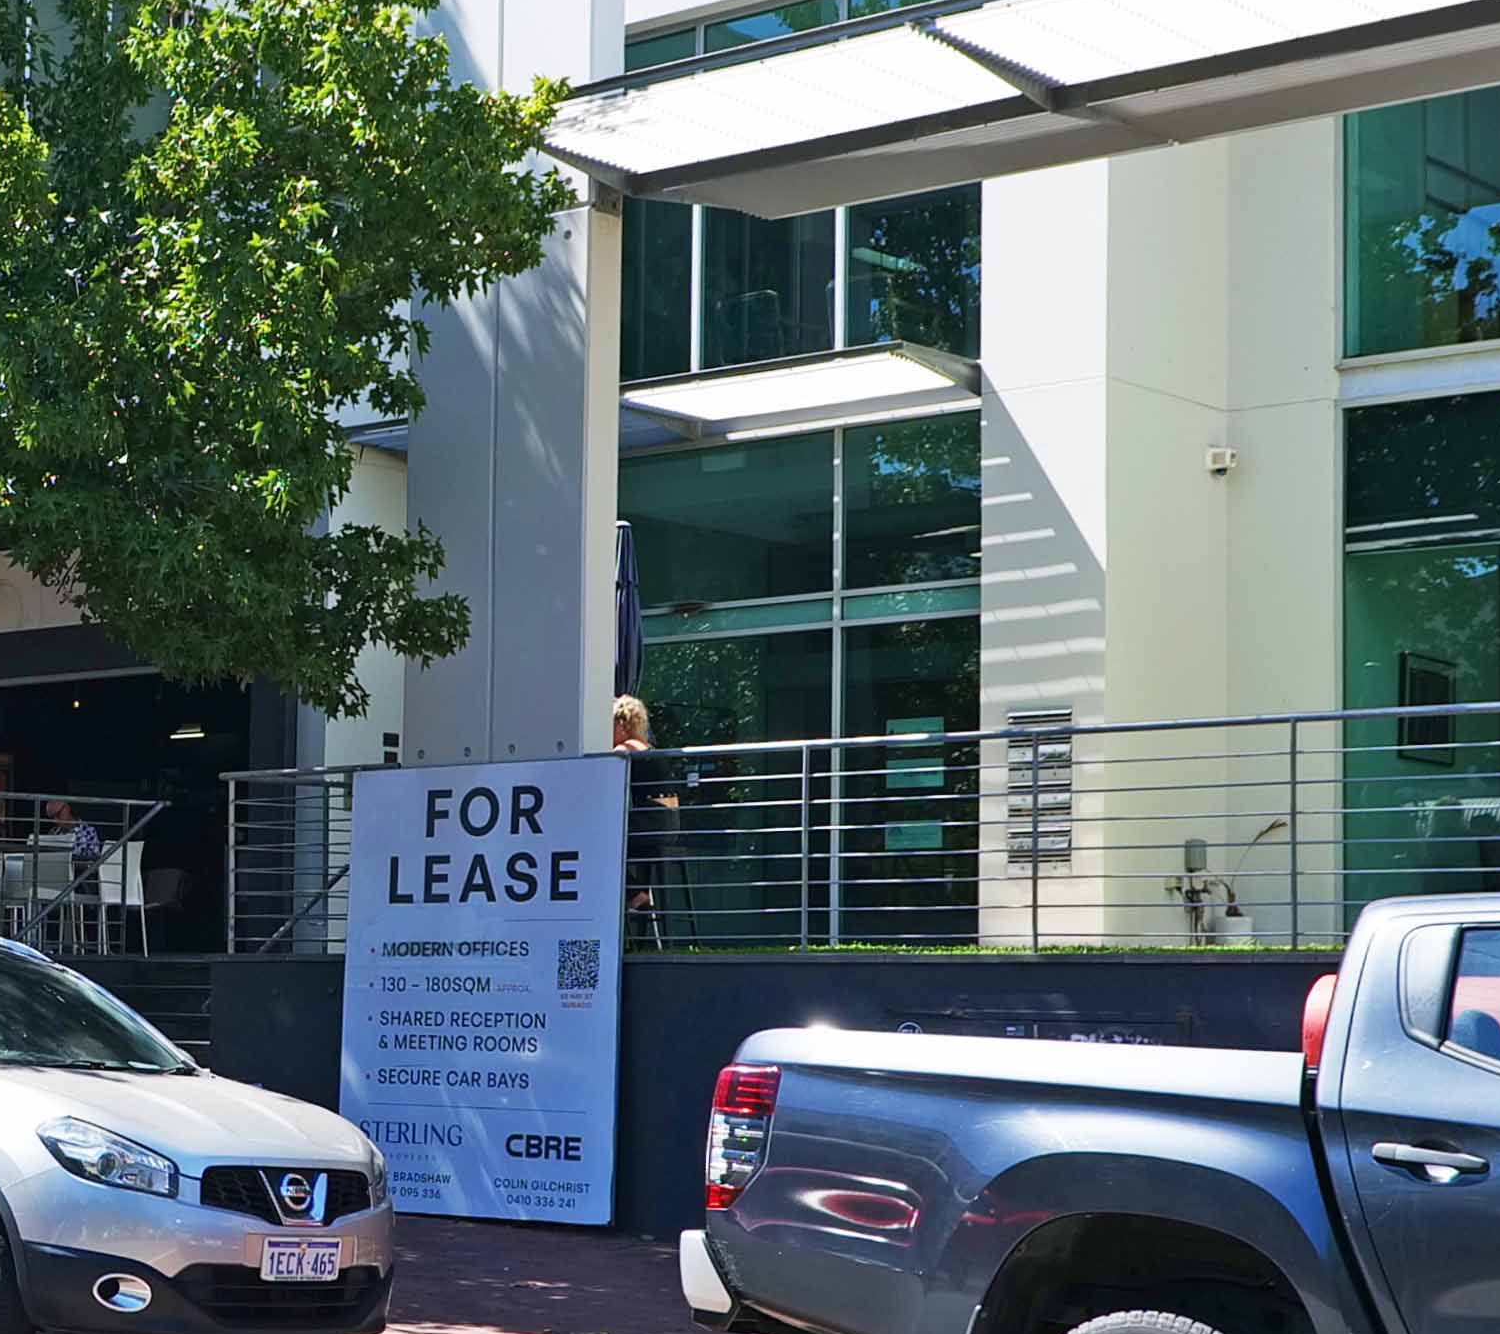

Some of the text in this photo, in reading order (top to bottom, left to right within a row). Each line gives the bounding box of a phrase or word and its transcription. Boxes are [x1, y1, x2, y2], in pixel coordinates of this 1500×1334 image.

[425, 785, 544, 838] FOR
[389, 850, 580, 904] LEASE
[382, 941, 529, 957] MODERN OFFICES
[381, 976, 406, 993] 130
[425, 976, 491, 995] 180SQM
[379, 1010, 547, 1029] SHARED RECEPTION
[378, 1034, 538, 1053] & MEETING ROOMS
[377, 1068, 529, 1089] SECURE CAR BAYS
[360, 1119, 463, 1147] STERLING
[505, 1134, 583, 1162] CBRE
[393, 1171, 452, 1185] BRADSHAW
[494, 1177, 591, 1194] COLIN GILCHRIST
[400, 1186, 419, 1198] 095
[422, 1187, 441, 1200] 336
[506, 1194, 576, 1209] 0410 336 241
